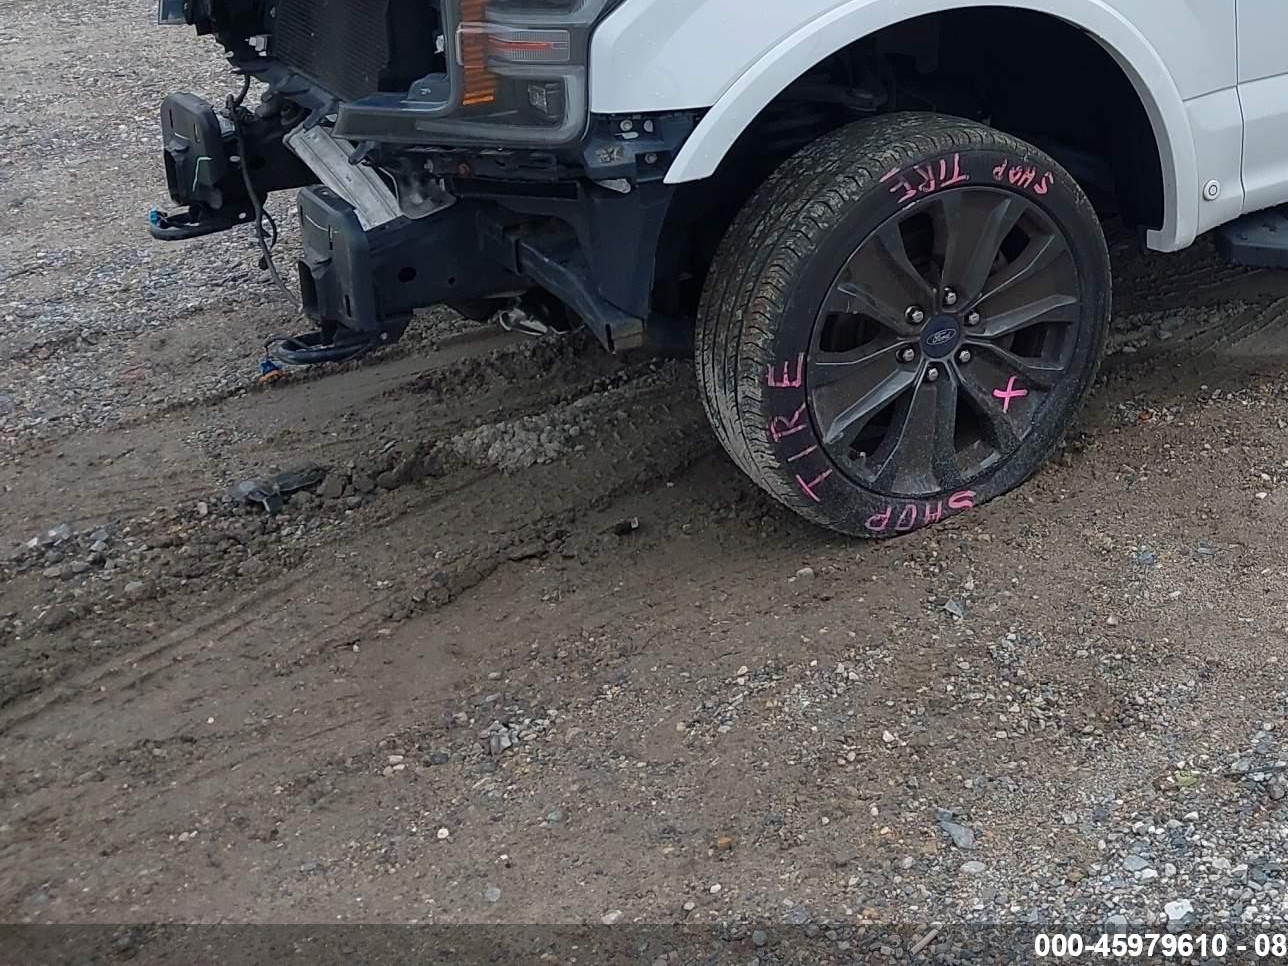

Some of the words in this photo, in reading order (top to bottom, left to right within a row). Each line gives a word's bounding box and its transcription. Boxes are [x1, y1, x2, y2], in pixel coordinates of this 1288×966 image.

[992, 158, 1054, 195] SHOP
[766, 351, 833, 502] TIRE
[865, 490, 976, 532] SHOP
